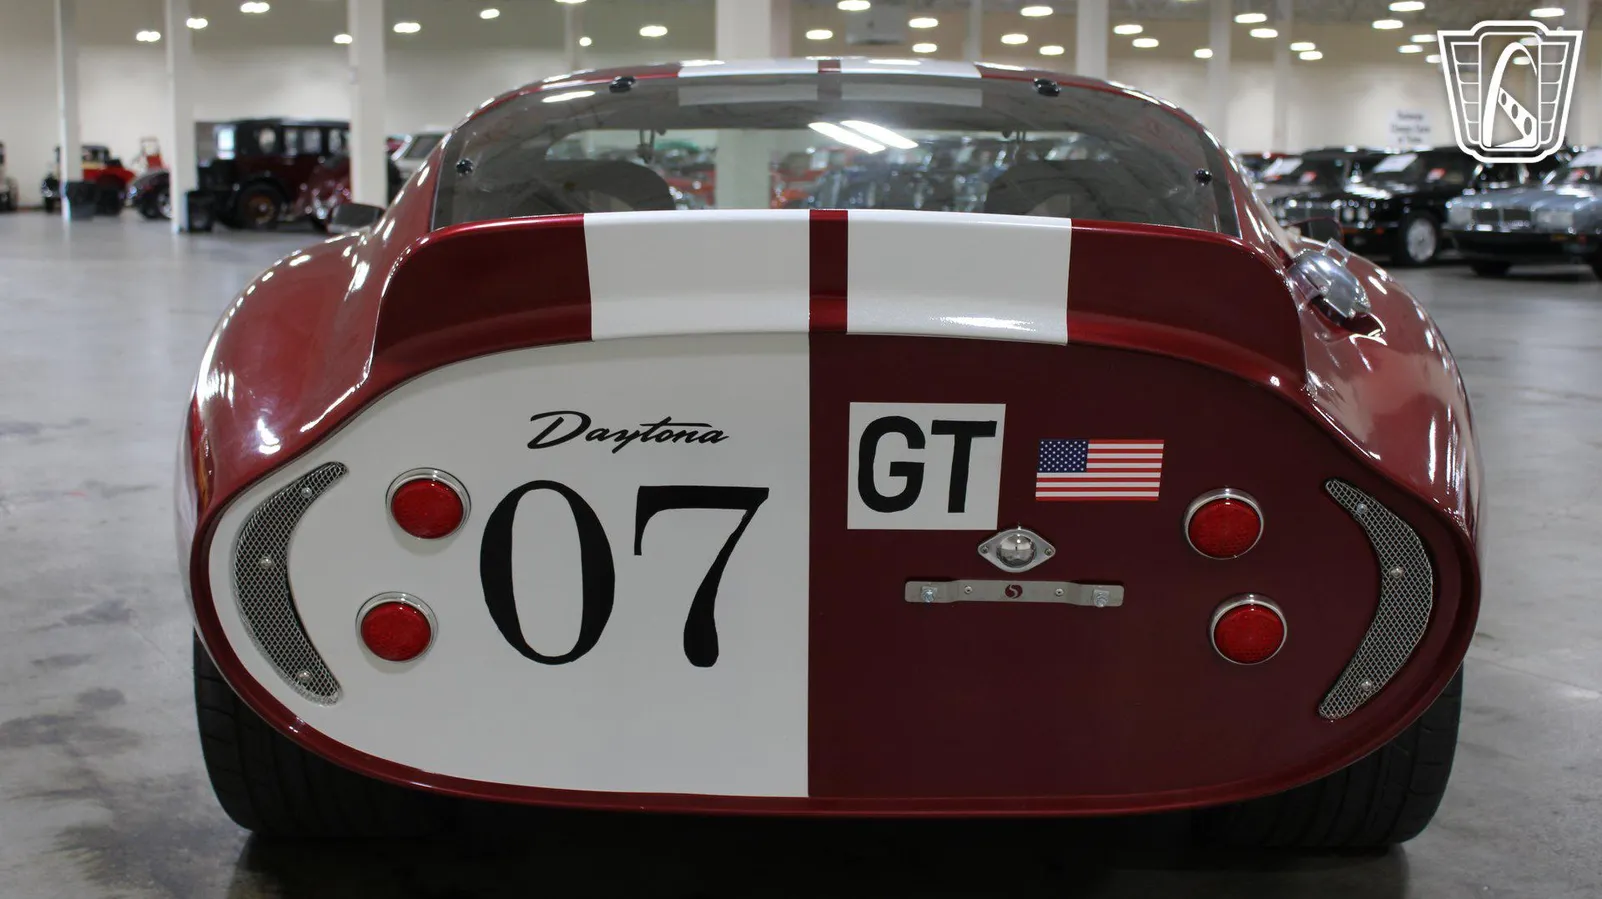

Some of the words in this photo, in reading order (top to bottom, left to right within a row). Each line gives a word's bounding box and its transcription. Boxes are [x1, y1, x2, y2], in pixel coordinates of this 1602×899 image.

[527, 410, 729, 454] Daytona
[858, 415, 997, 513] GT
[479, 479, 770, 668] 07
